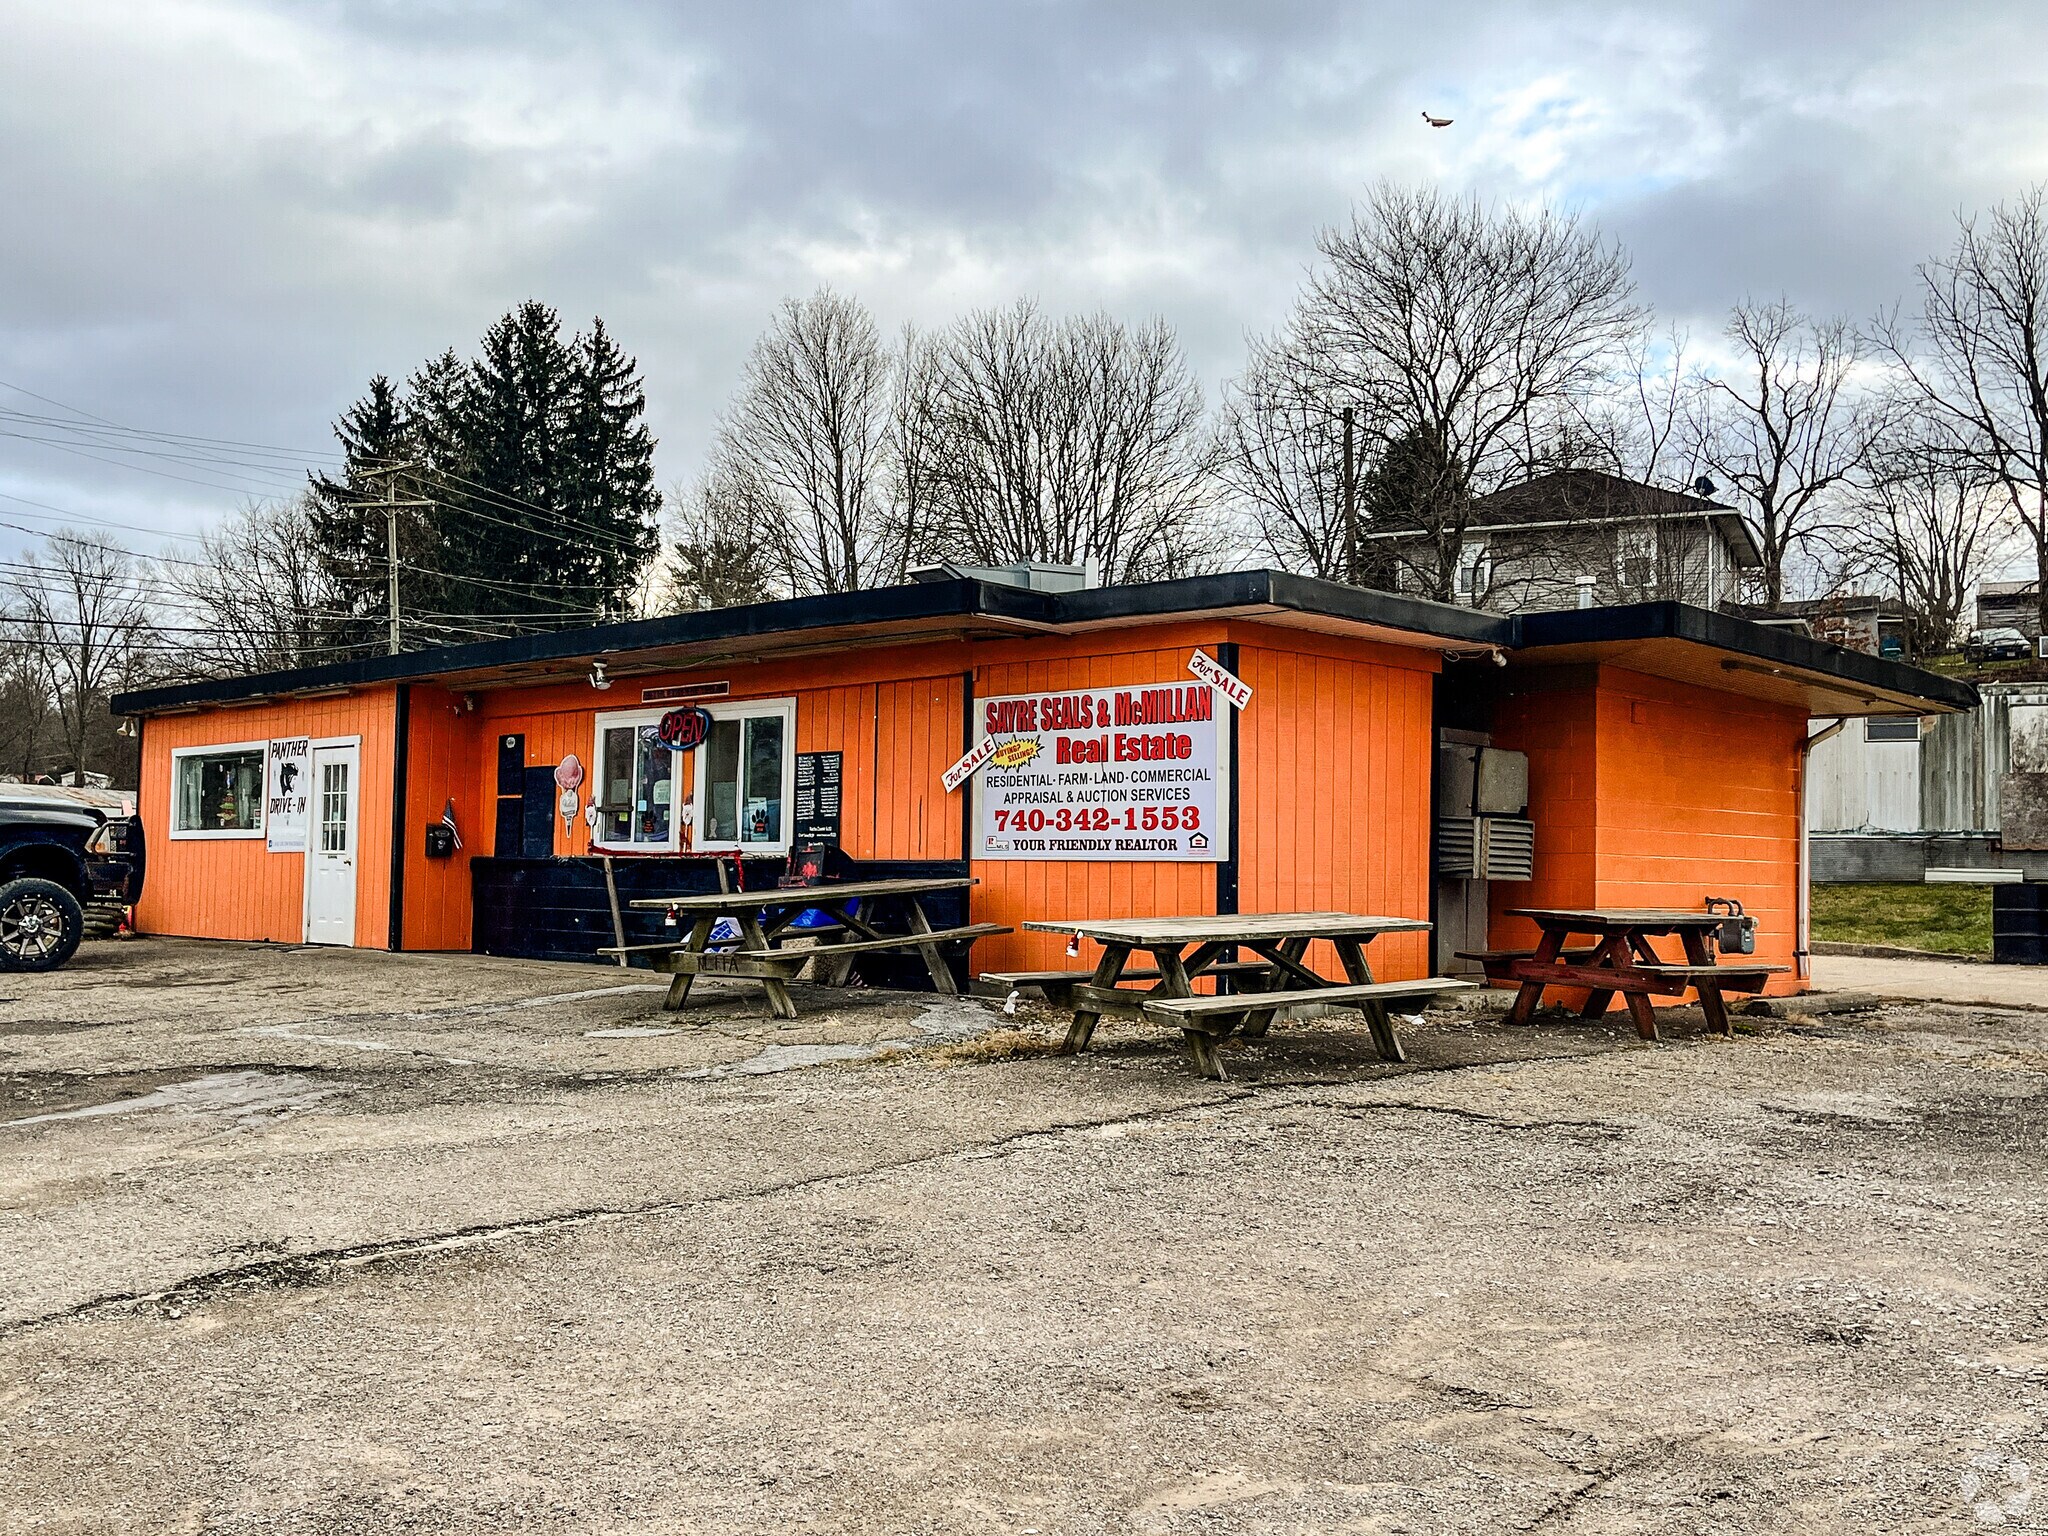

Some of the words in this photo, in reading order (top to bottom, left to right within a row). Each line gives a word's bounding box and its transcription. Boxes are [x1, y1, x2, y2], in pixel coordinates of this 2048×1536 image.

[1192, 655, 1213, 676] For
[1210, 669, 1248, 705] SALE
[986, 699, 1037, 734] SAYRE
[1041, 694, 1093, 731] SEALS
[1096, 698, 1111, 728] &
[1114, 686, 1212, 726] McMILLAN
[659, 711, 704, 743] OPEN
[271, 740, 308, 760] PANTHER
[996, 744, 1021, 758] BUYING?
[1007, 747, 1034, 762] SELLING?
[1056, 735, 1108, 765] Real
[1114, 732, 1192, 763] Estate
[945, 767, 962, 787] For
[962, 739, 993, 773] SALE
[1058, 772, 1088, 786] FARM
[1094, 771, 1124, 784] LAND
[1130, 768, 1211, 783] COMMERCIAL
[1003, 790, 1063, 804] APPRAISAL
[1066, 790, 1074, 803] &
[1076, 789, 1127, 803] AUCTION
[1130, 787, 1190, 801] SERVICES
[994, 806, 1200, 832] 740-342-1553
[1013, 839, 1046, 851] YOUR
[1049, 838, 1112, 851] FRIENDLY
[1115, 838, 1178, 850] REALTOR
